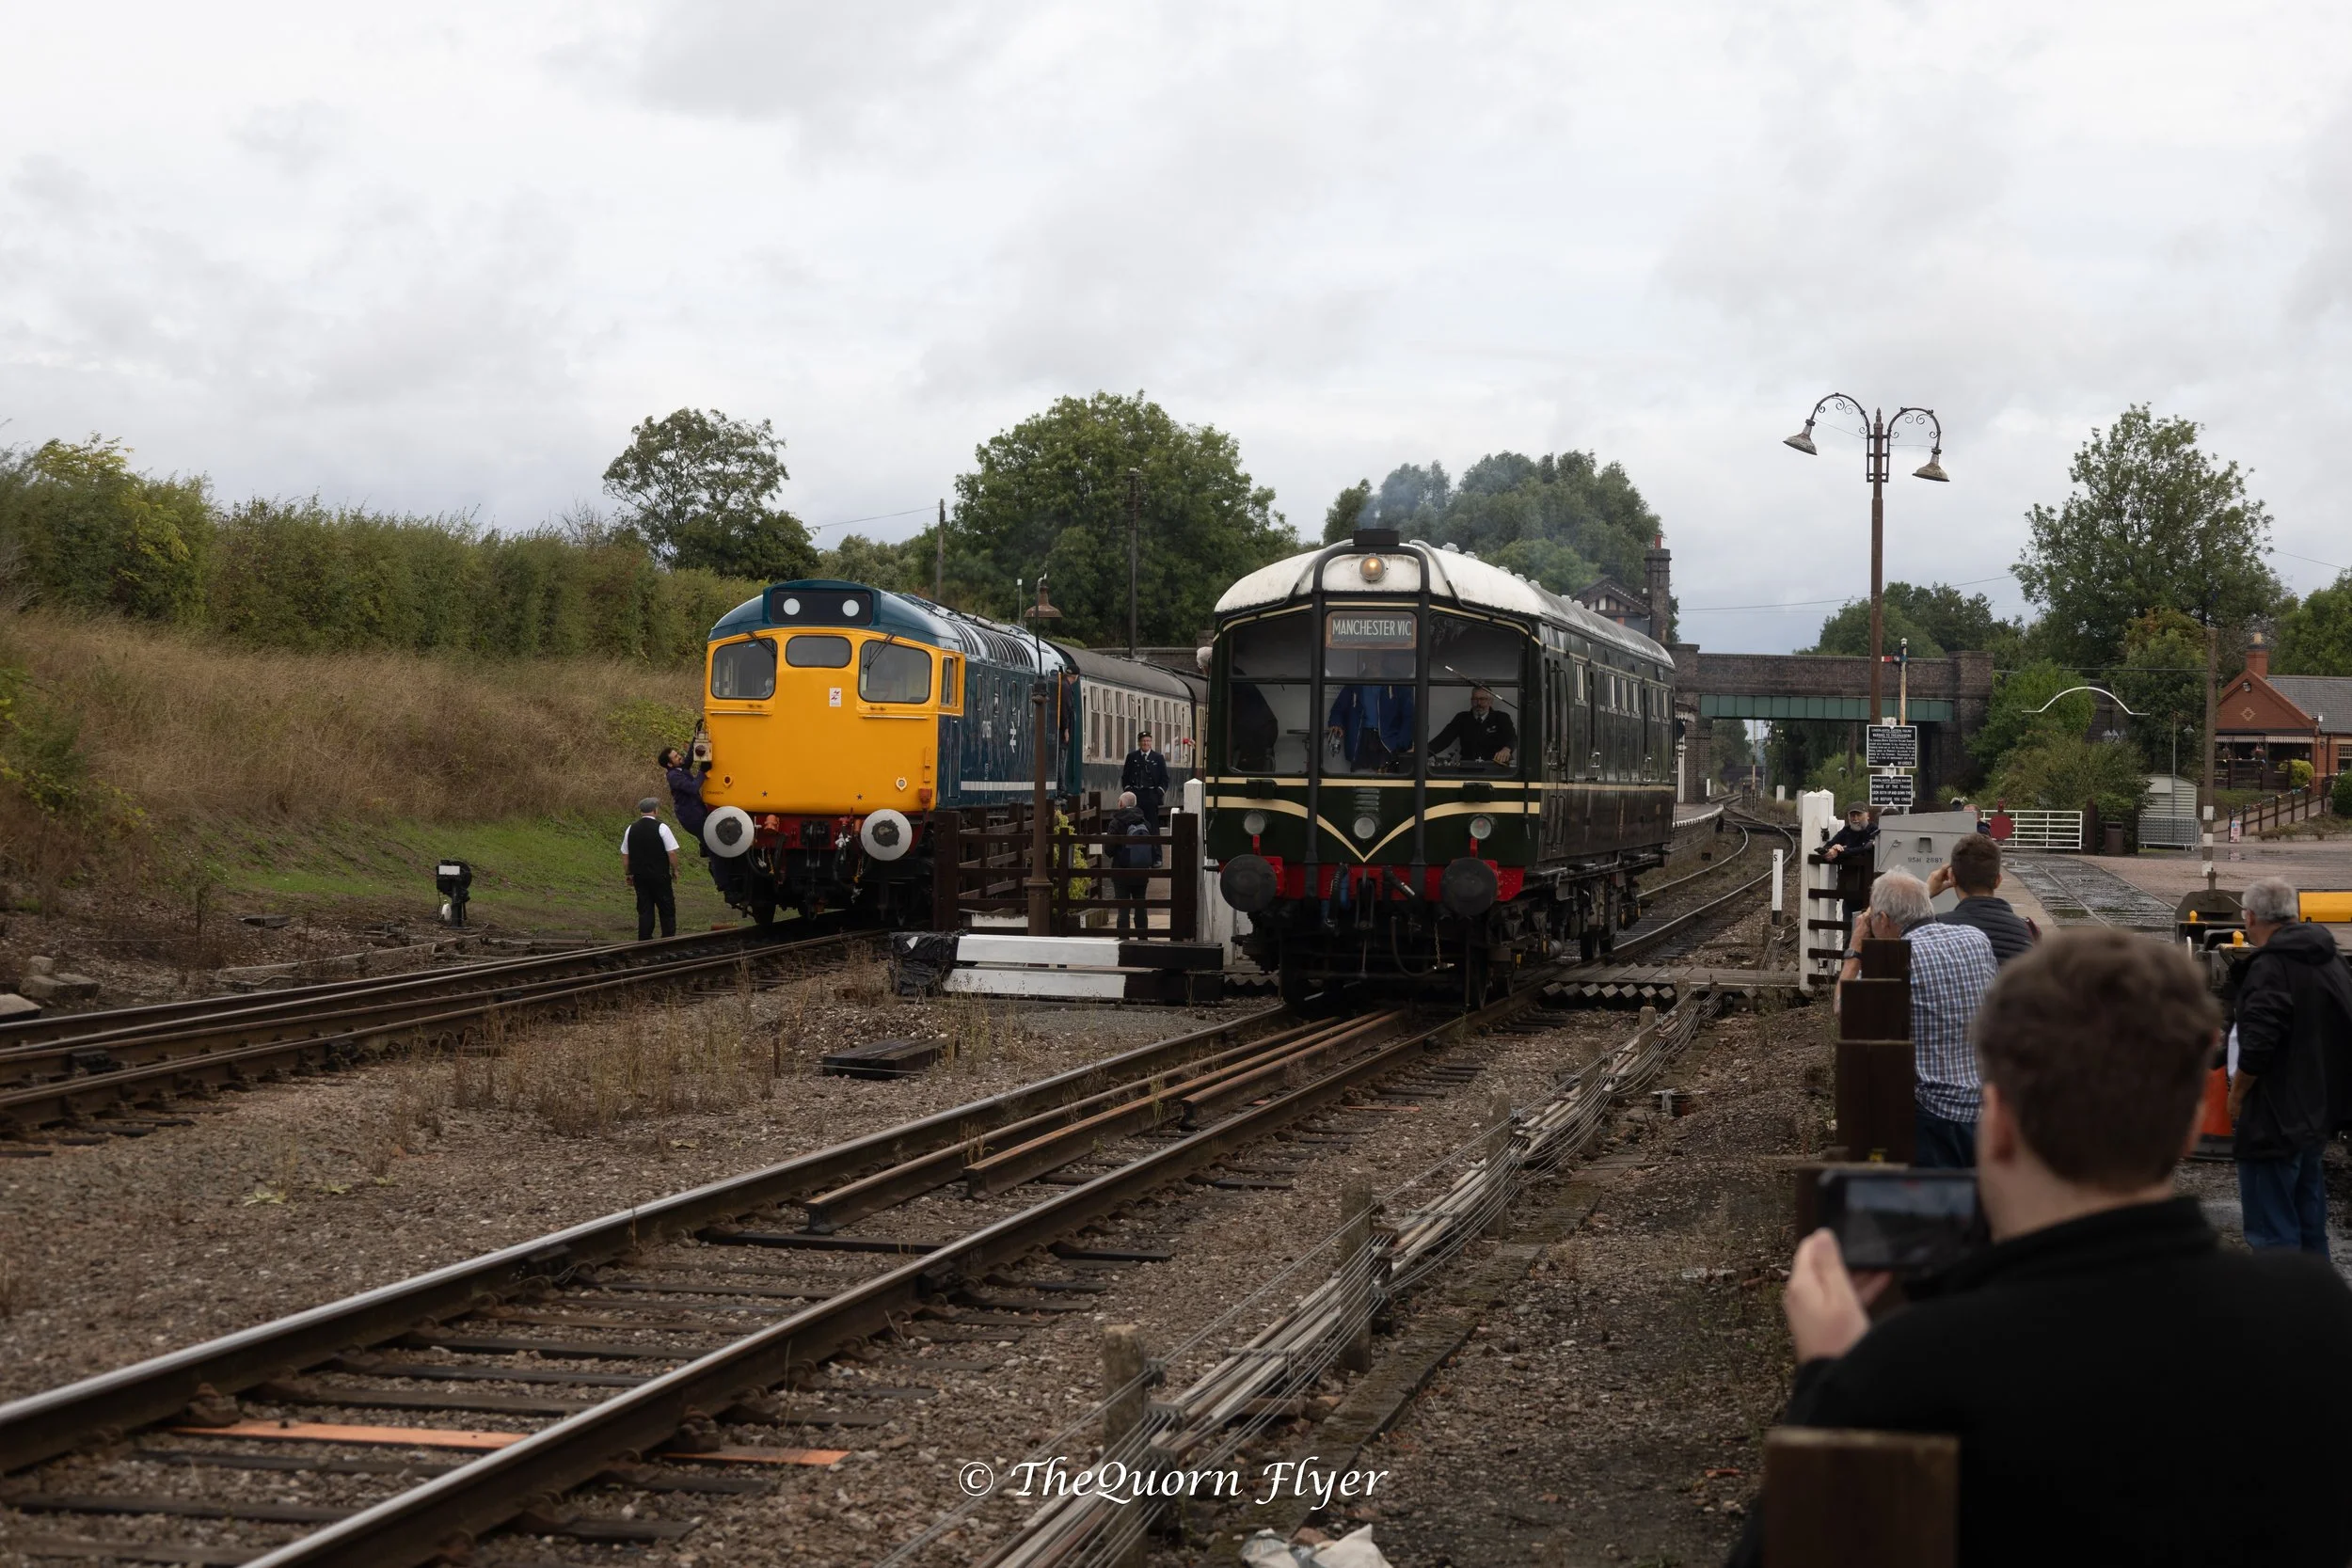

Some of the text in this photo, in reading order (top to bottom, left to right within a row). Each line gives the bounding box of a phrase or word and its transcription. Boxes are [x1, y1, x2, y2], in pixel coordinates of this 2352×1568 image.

[1332, 619, 1412, 636] MANCHESTER VIC
[1773, 854, 1778, 863] S
